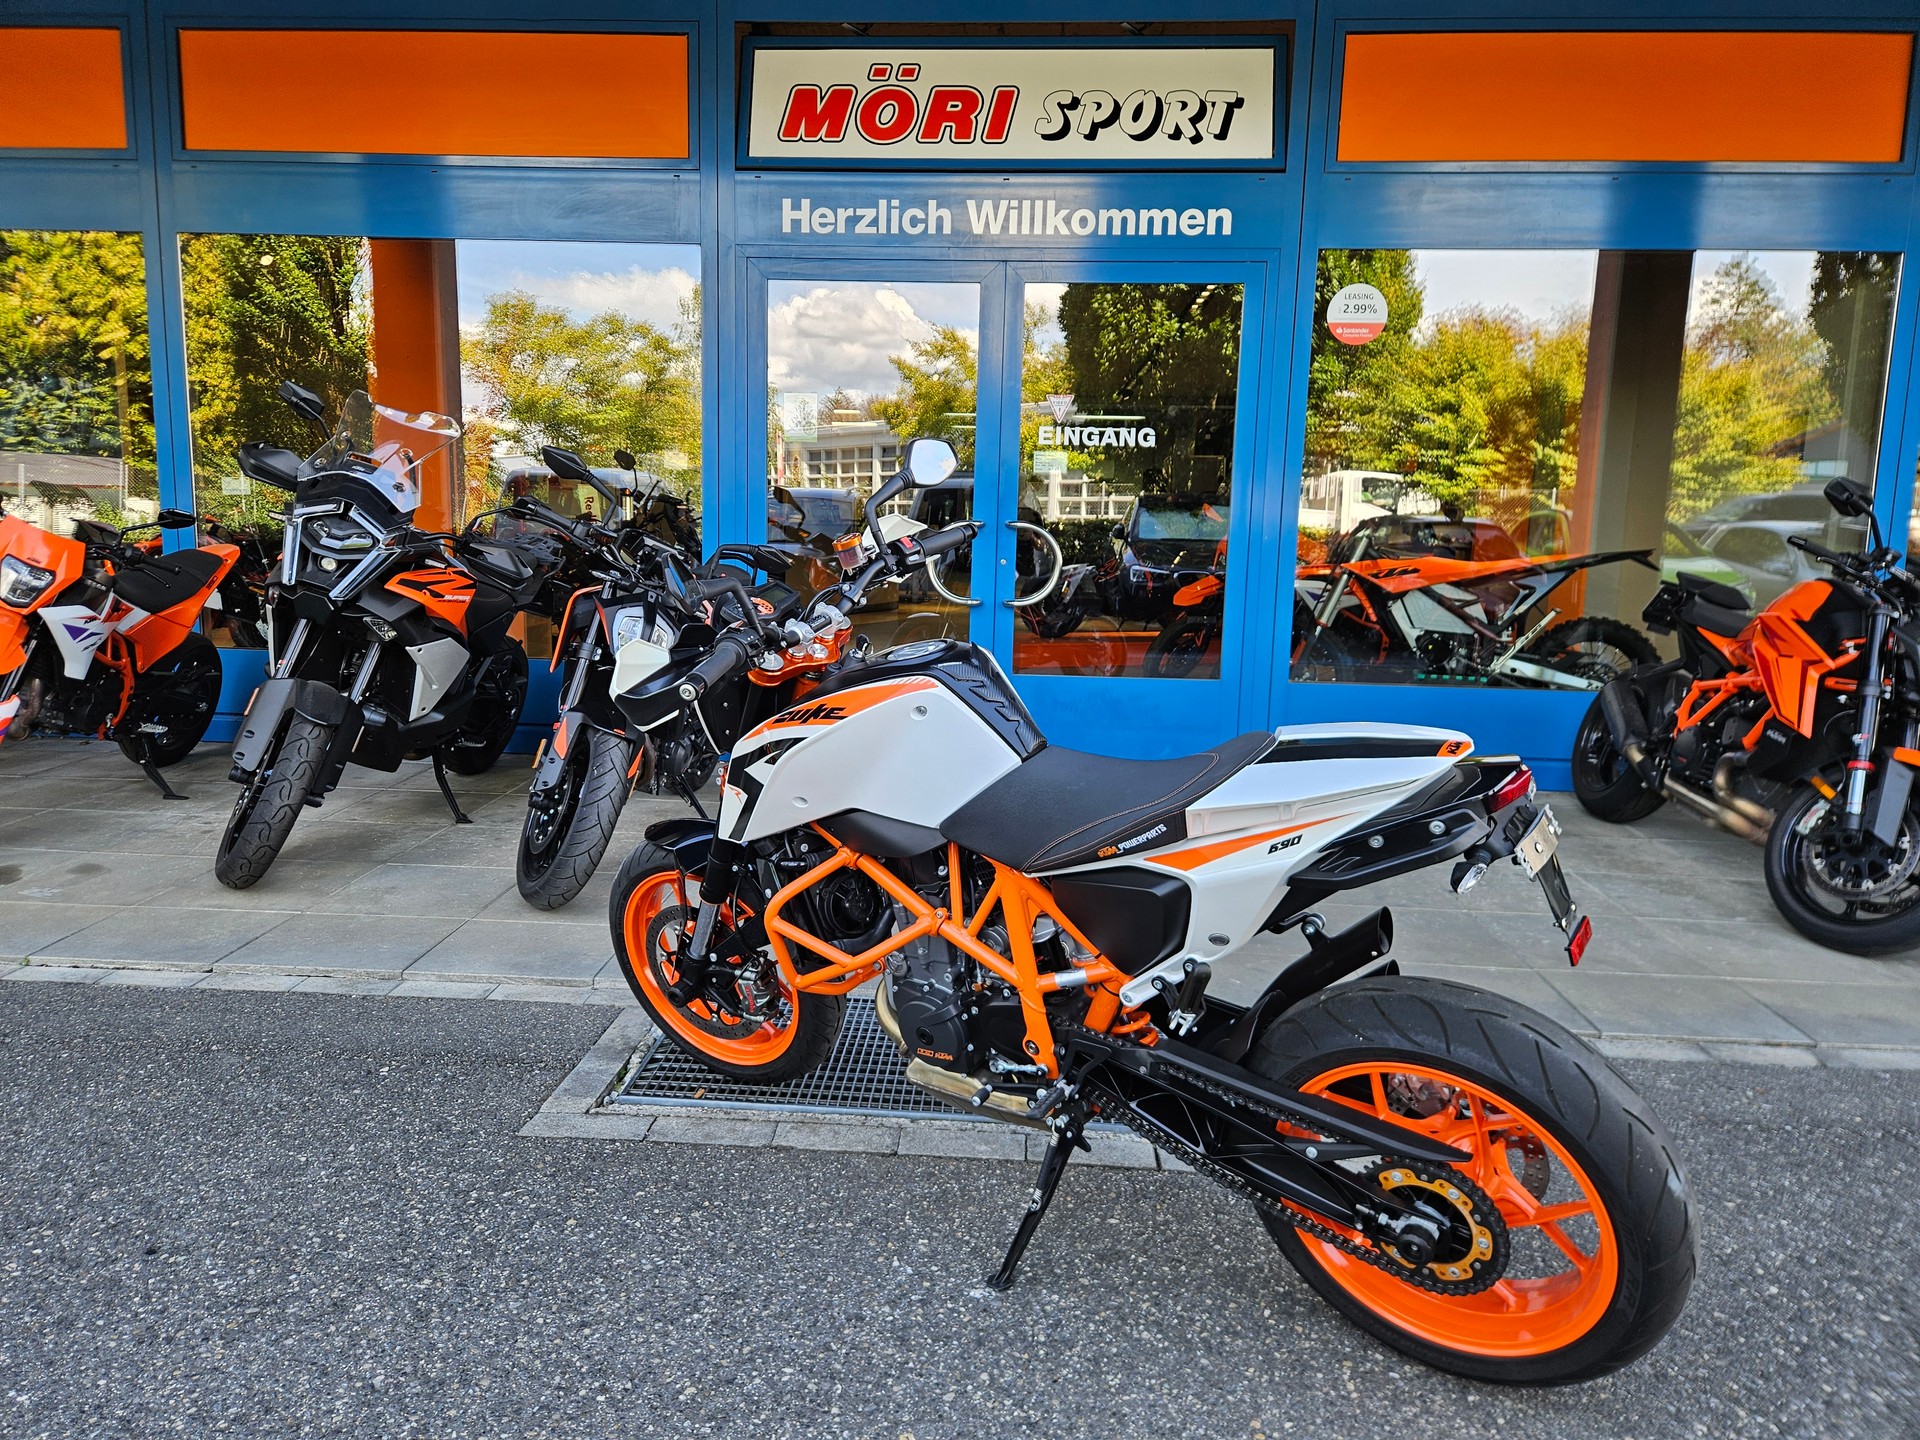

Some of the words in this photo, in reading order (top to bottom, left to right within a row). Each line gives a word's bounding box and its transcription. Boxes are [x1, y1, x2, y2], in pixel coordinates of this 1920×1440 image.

[777, 63, 1019, 145] MÖRI
[1035, 89, 1245, 144] SPORT
[781, 198, 952, 235] Herzlich
[966, 199, 1233, 236] Willkommen
[1343, 303, 1378, 314] 2.99%
[1039, 425, 1156, 448] EINGANG
[772, 703, 849, 724] DUKE
[1267, 834, 1303, 855] 690
